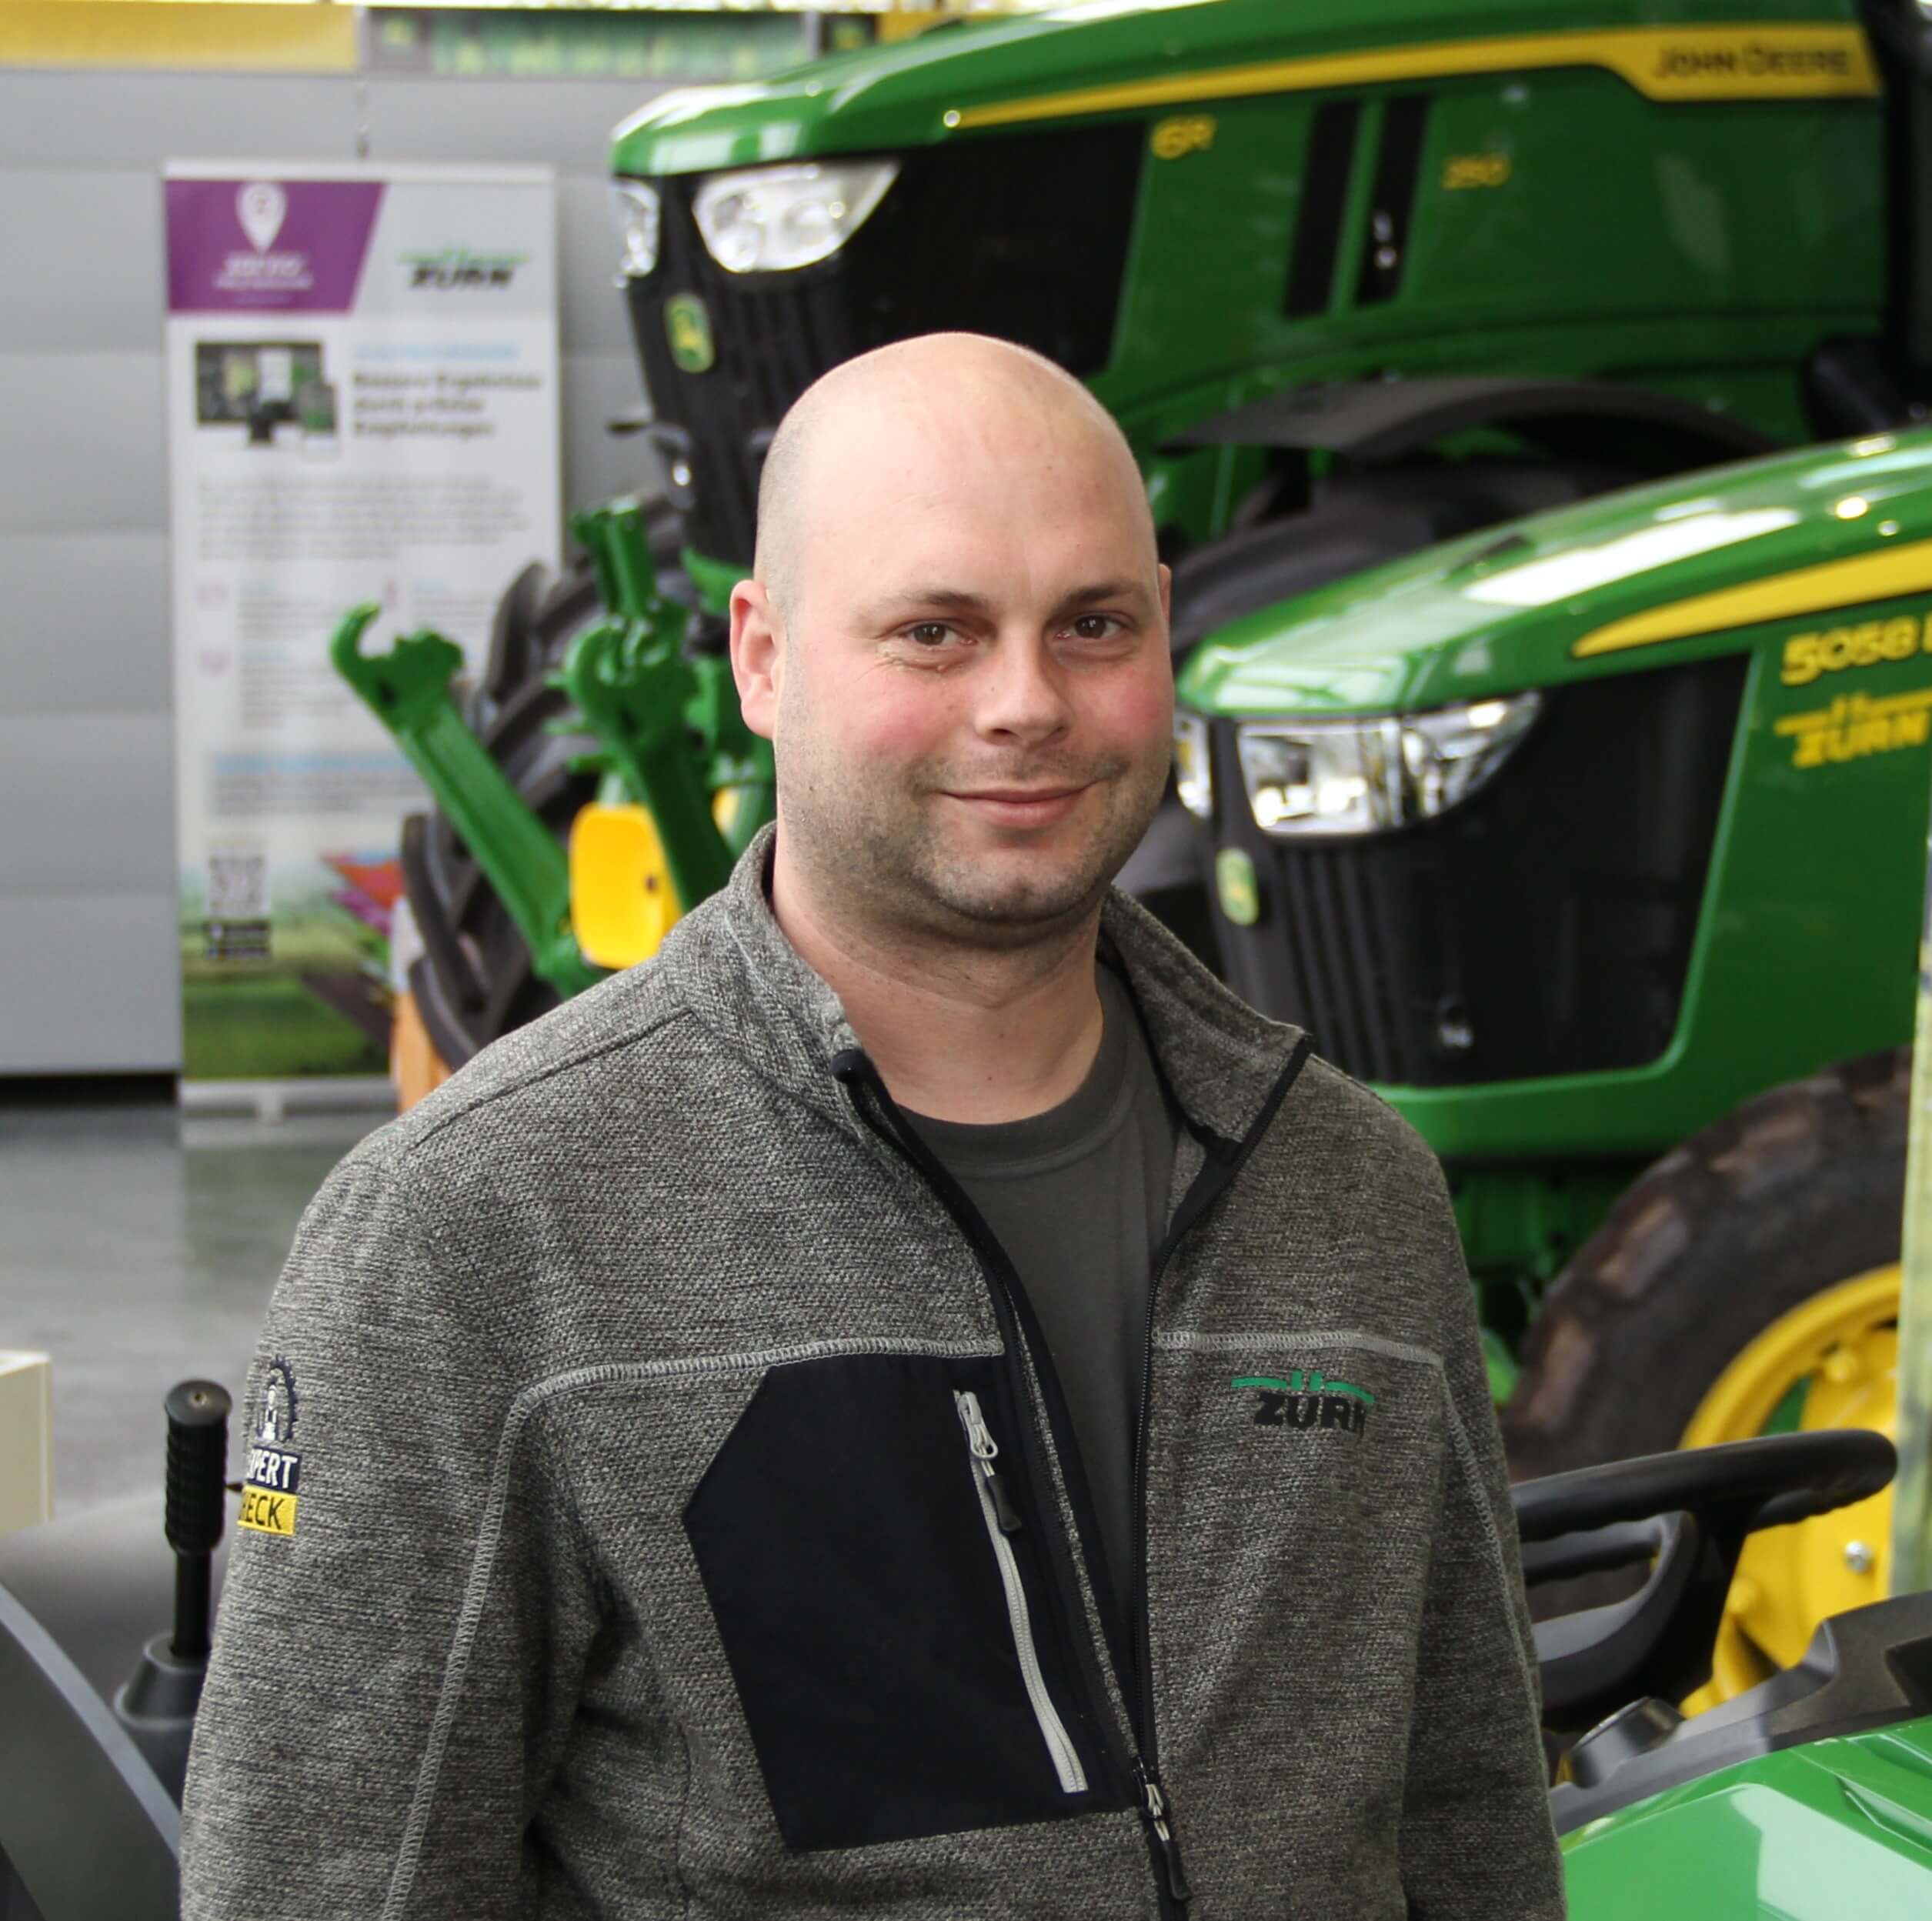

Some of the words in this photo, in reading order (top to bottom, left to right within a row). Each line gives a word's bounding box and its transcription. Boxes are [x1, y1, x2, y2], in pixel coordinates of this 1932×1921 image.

[1654, 46, 1736, 78] JOHN
[1741, 44, 1850, 76] DEERE
[1780, 613, 1932, 684] 5058
